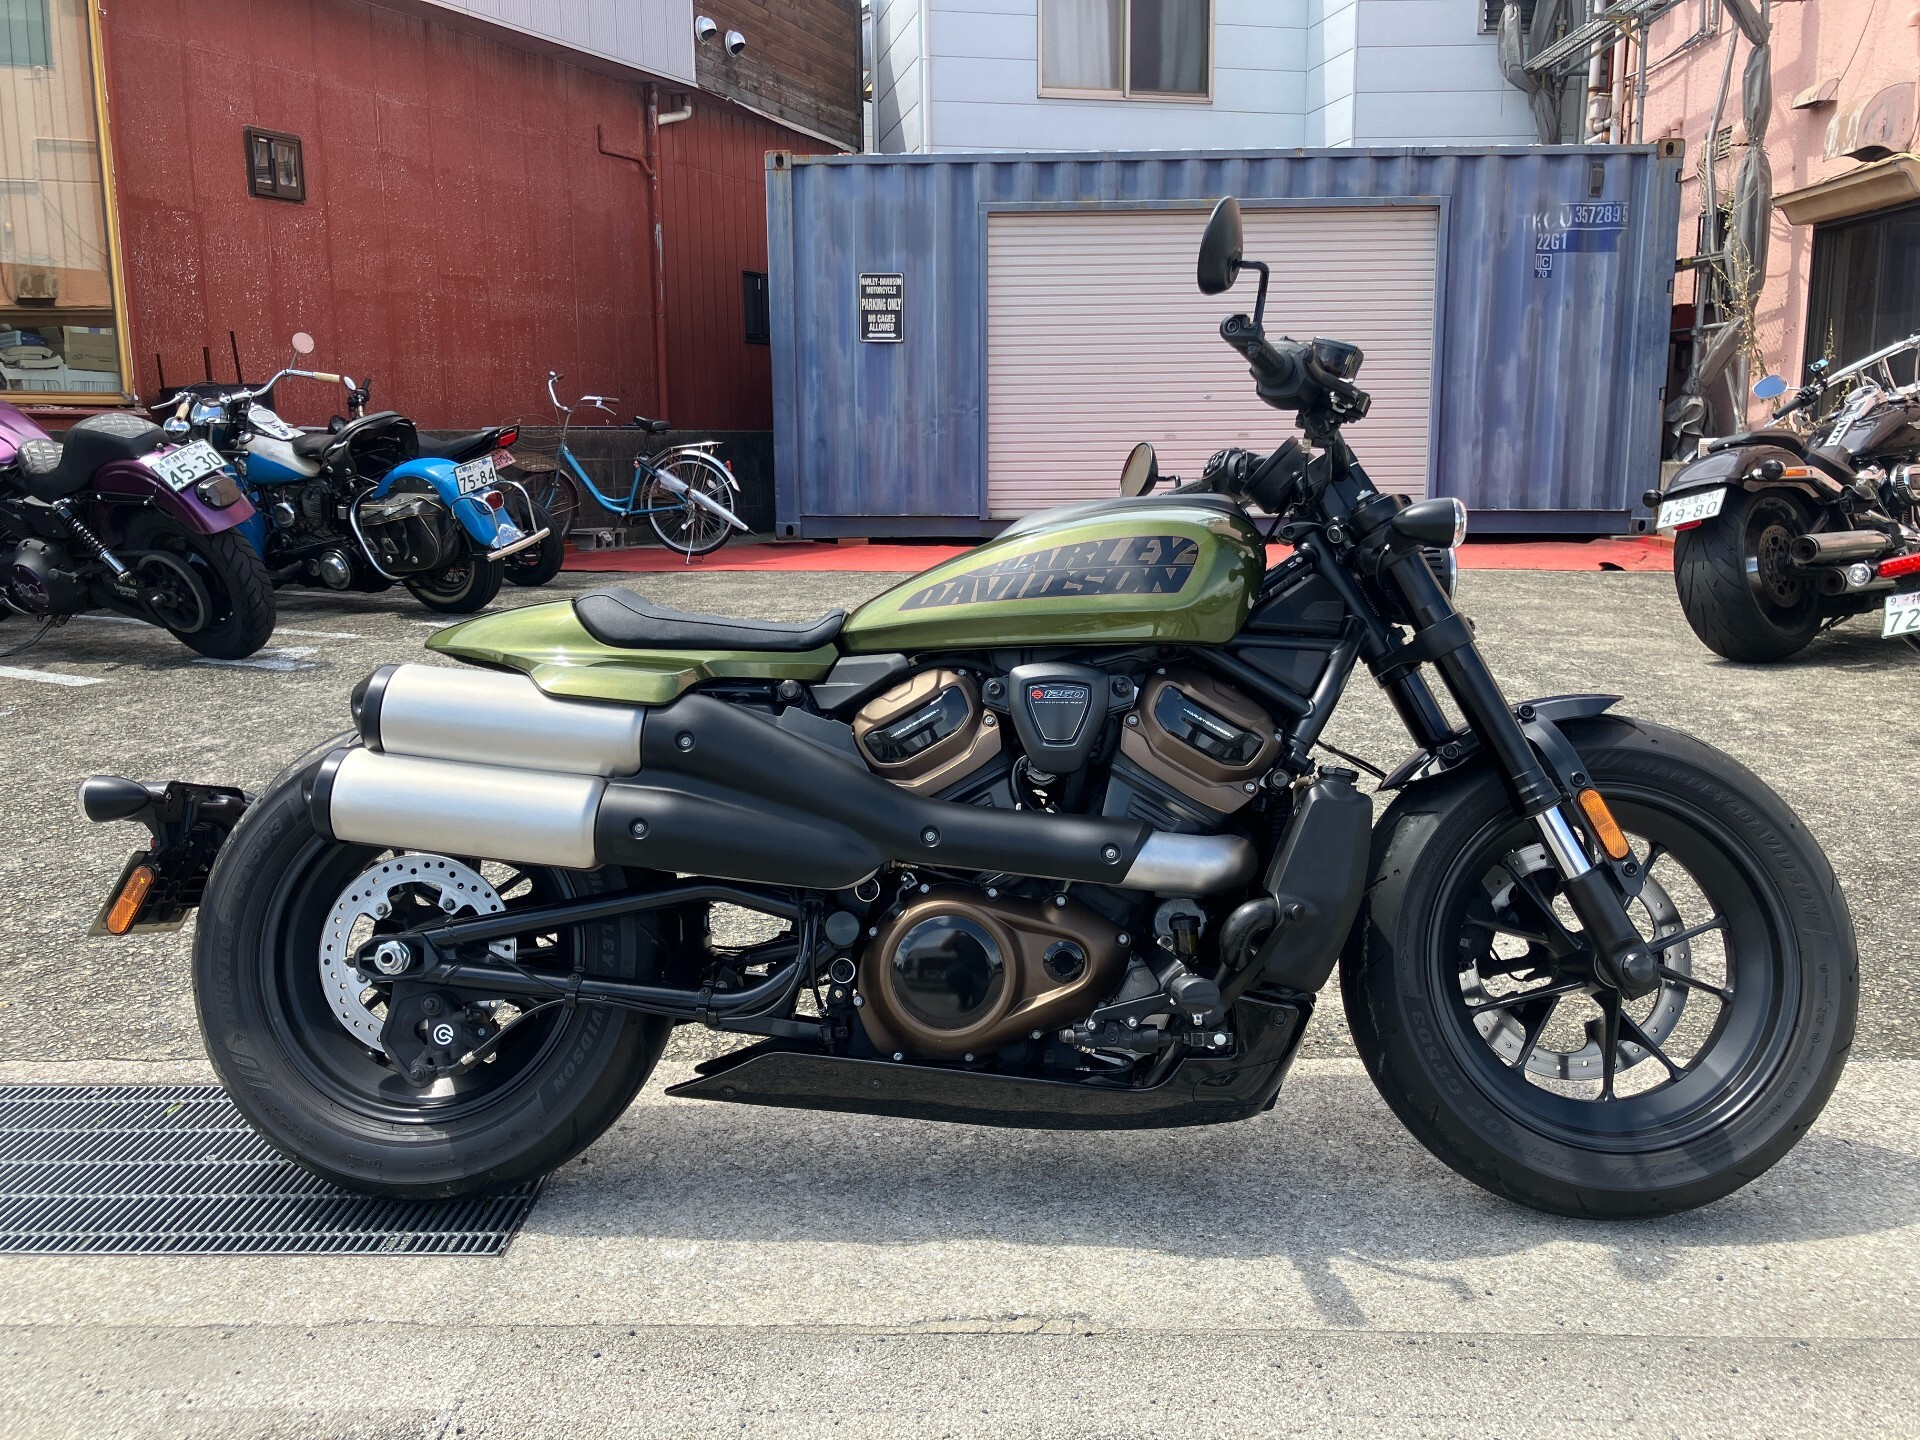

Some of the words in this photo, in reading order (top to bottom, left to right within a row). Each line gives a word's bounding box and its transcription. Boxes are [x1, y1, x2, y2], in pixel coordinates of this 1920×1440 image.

[1536, 232, 1567, 251] 22G1
[1537, 269, 1548, 278] 70
[866, 286, 896, 294] MOTORCYCLE
[862, 299, 886, 310] PARKING
[887, 299, 901, 310] ONLY
[868, 314, 876, 323] NO
[877, 314, 896, 323] CAGES
[869, 323, 895, 331] ALLOWED
[169, 451, 222, 485] 45-30
[459, 467, 495, 493] 75-84
[1661, 501, 1718, 525] 49-80
[898, 566, 1197, 611] DAVIDSON
[1411, 1009, 1465, 1097] GT503
